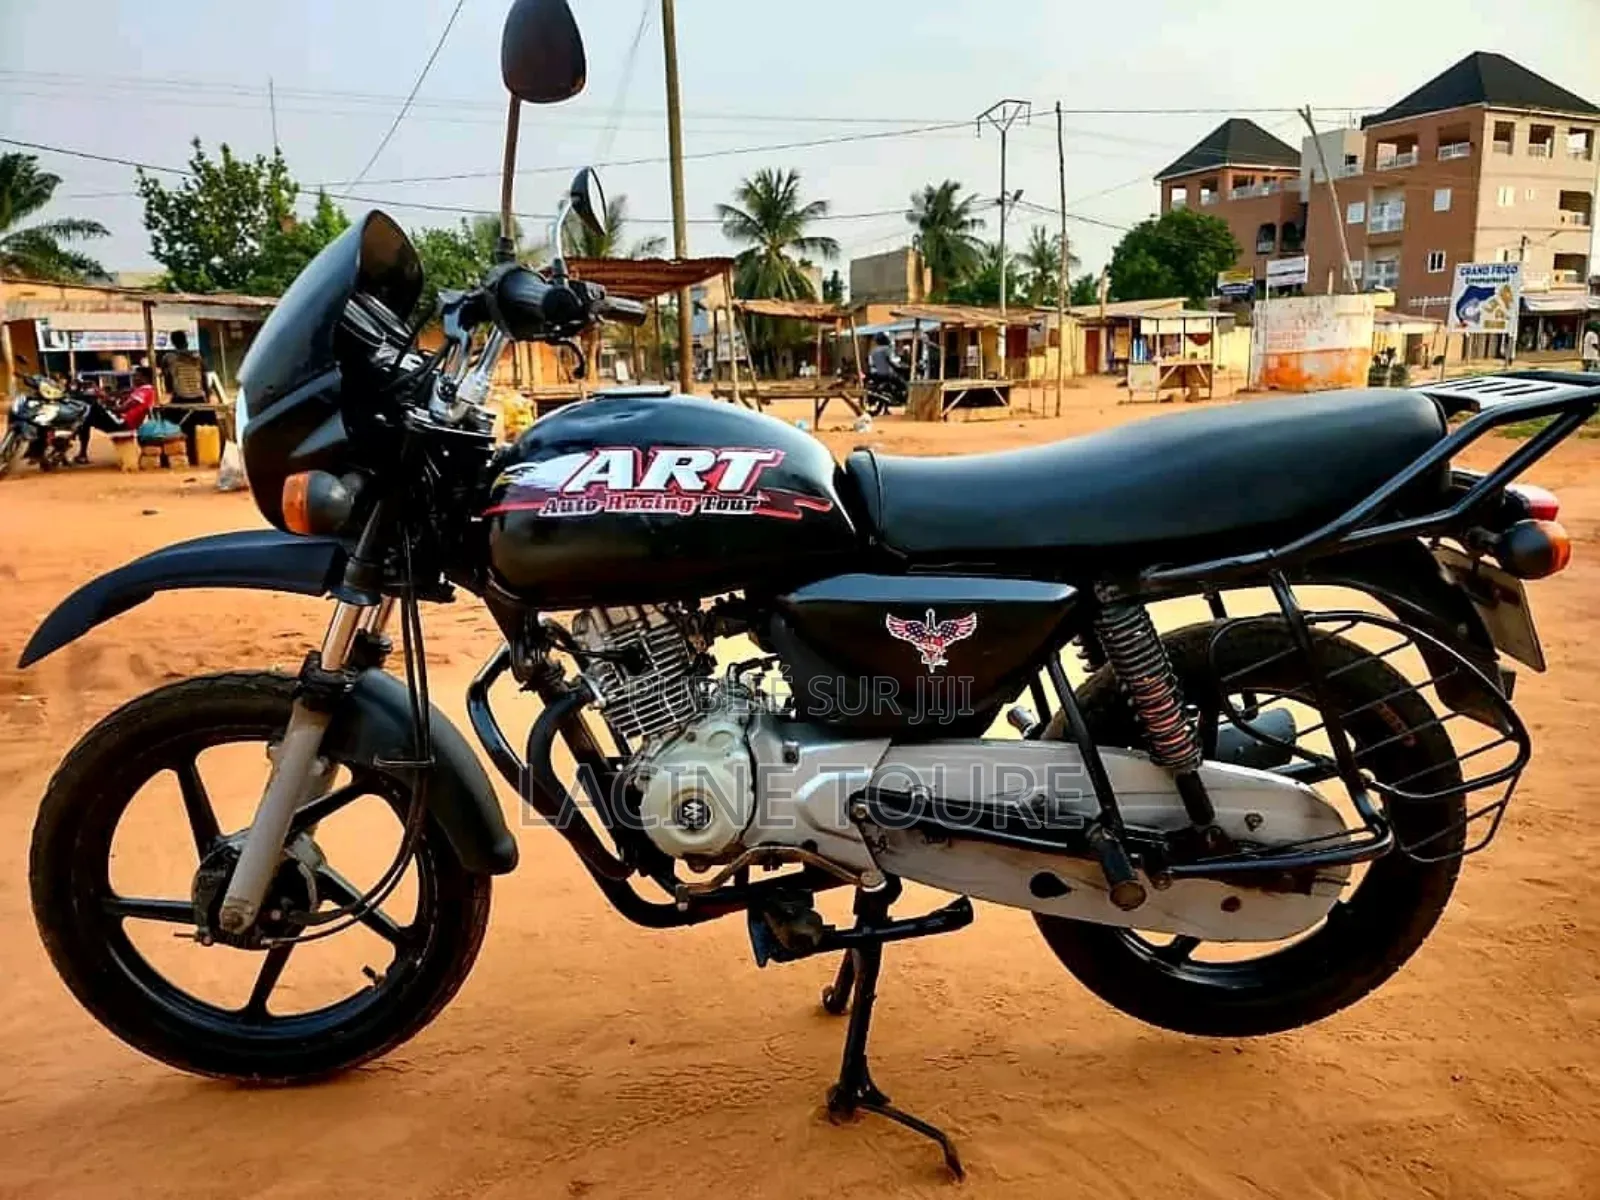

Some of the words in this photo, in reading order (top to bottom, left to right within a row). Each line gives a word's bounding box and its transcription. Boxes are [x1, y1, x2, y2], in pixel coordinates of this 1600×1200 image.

[1460, 266, 1490, 276] GRAND
[1491, 265, 1518, 274] FRIGO
[561, 448, 782, 494] ART
[540, 497, 599, 516] Auto
[604, 494, 693, 516] Racing
[700, 495, 759, 513] Tour
